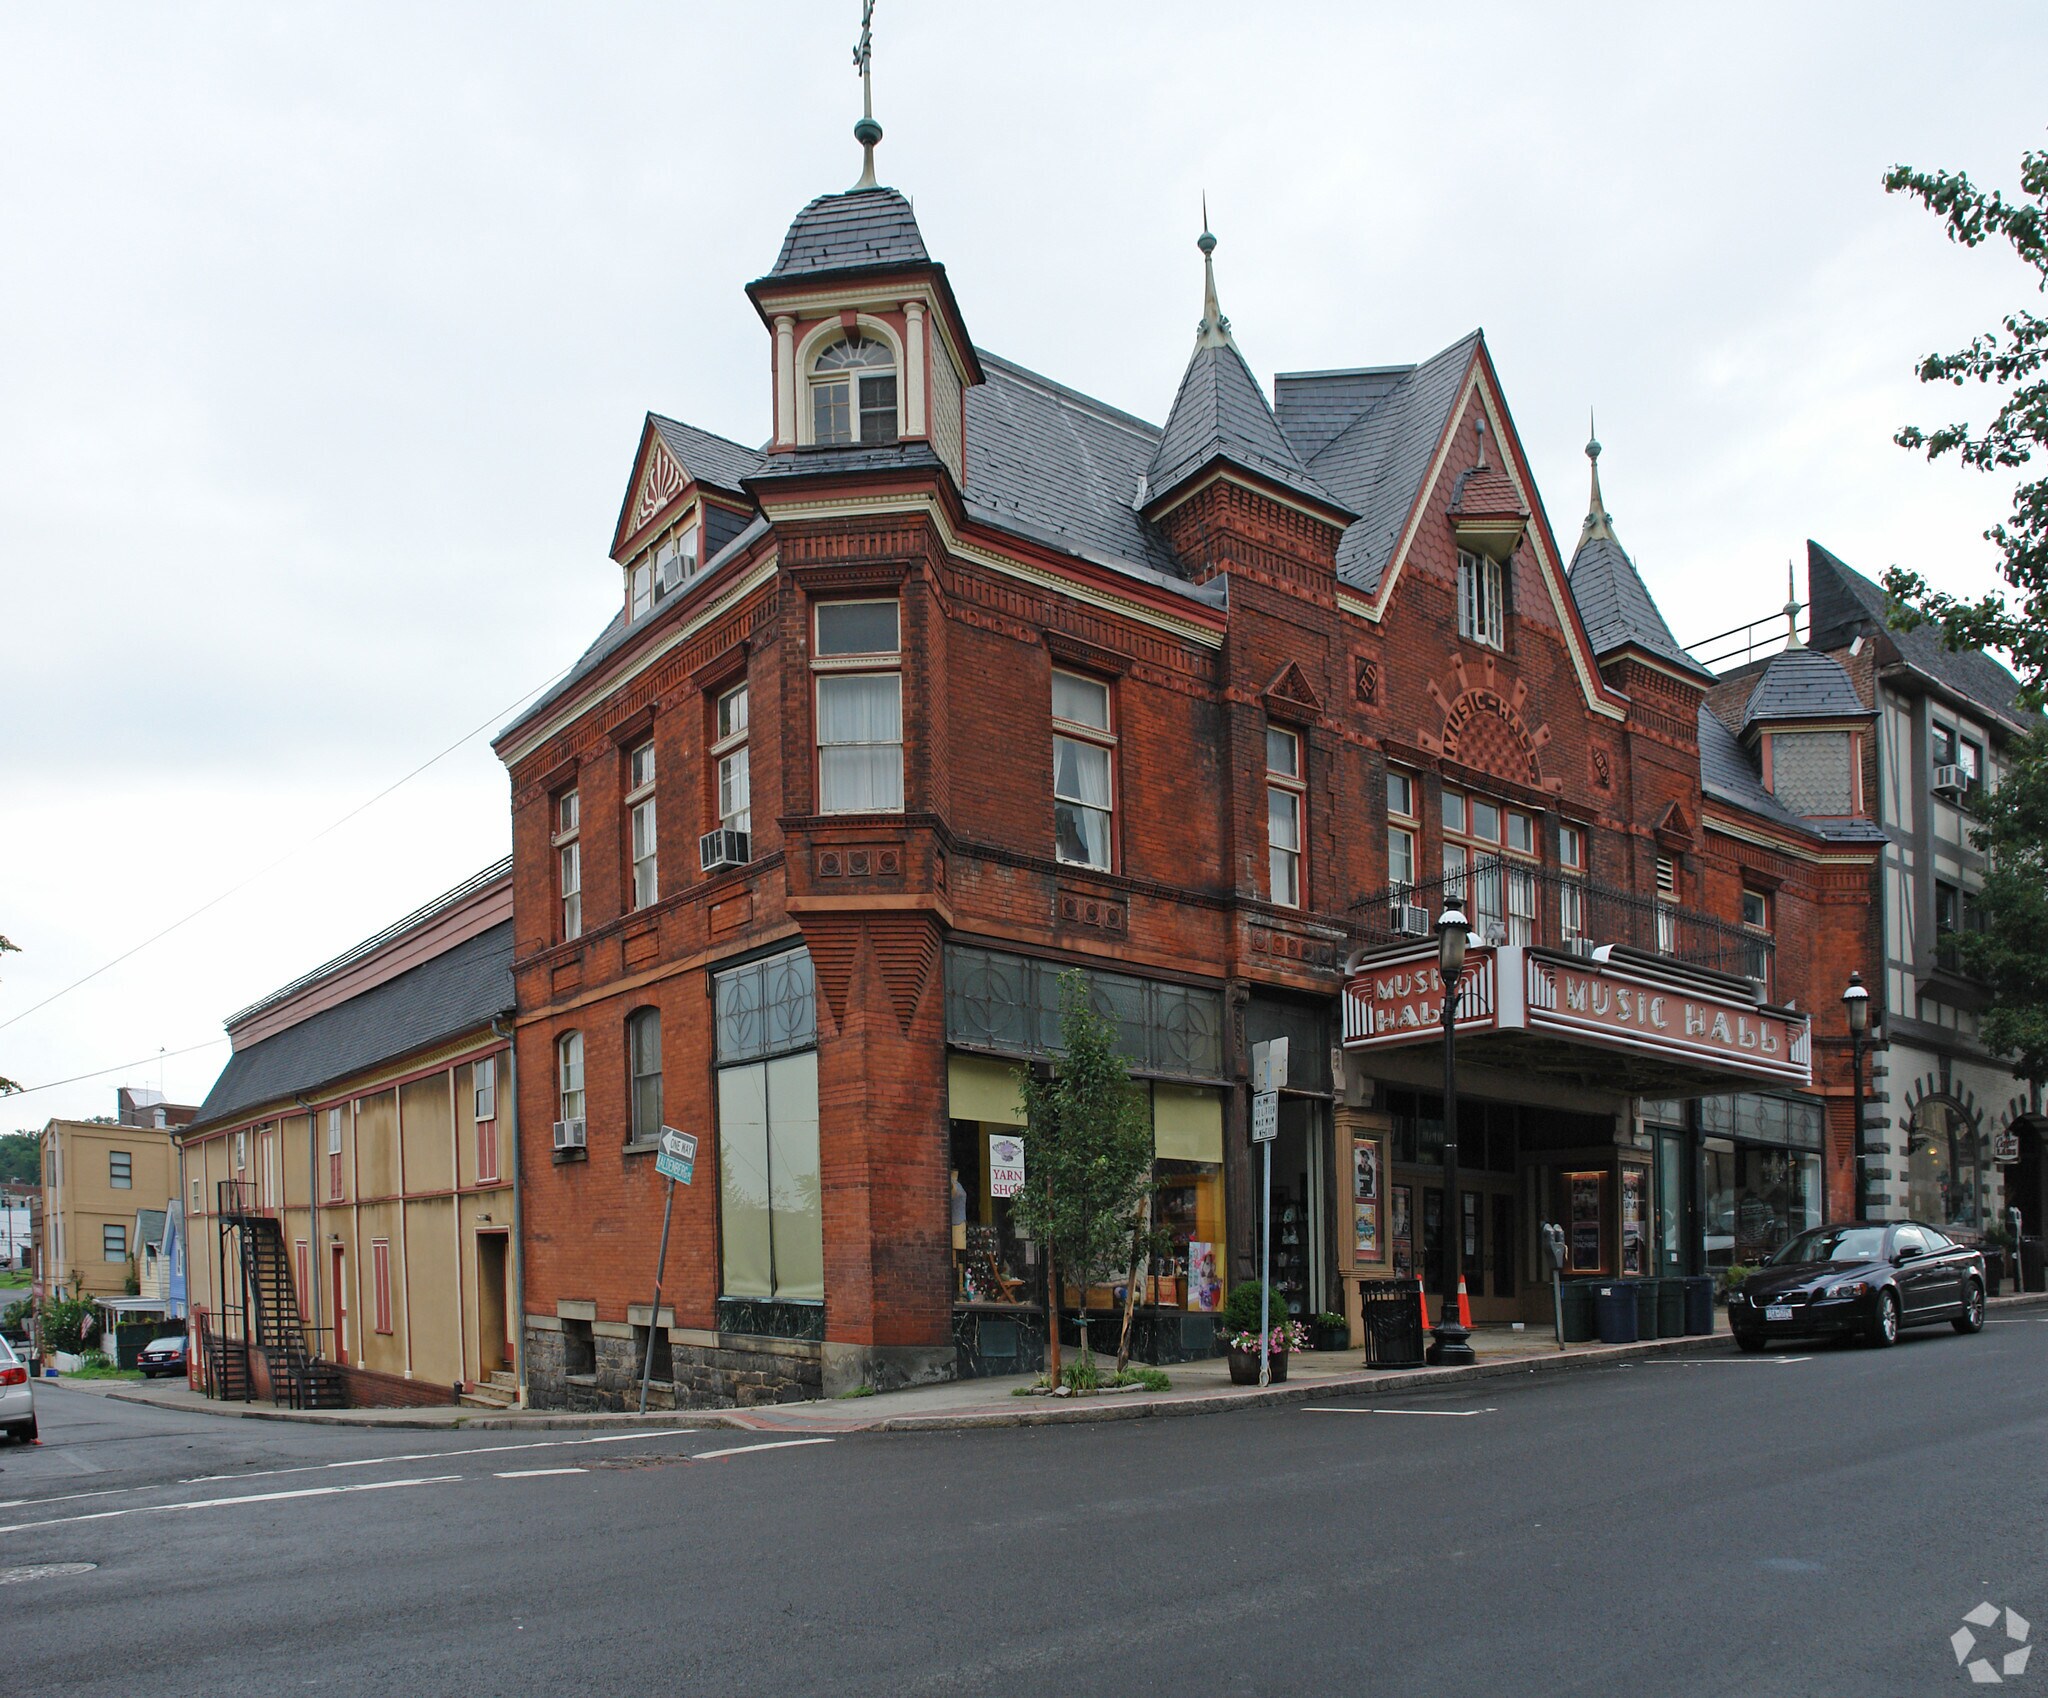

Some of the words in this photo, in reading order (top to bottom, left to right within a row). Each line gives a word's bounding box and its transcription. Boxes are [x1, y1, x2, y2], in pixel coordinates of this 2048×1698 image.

[1376, 968, 1447, 1001] MUSI
[1566, 976, 1669, 1030] MUSIC
[1684, 1003, 1779, 1054] HALL
[671, 1138, 681, 1152] ONE
[681, 1142, 693, 1156] WAY
[993, 1169, 1023, 1181] YARN
